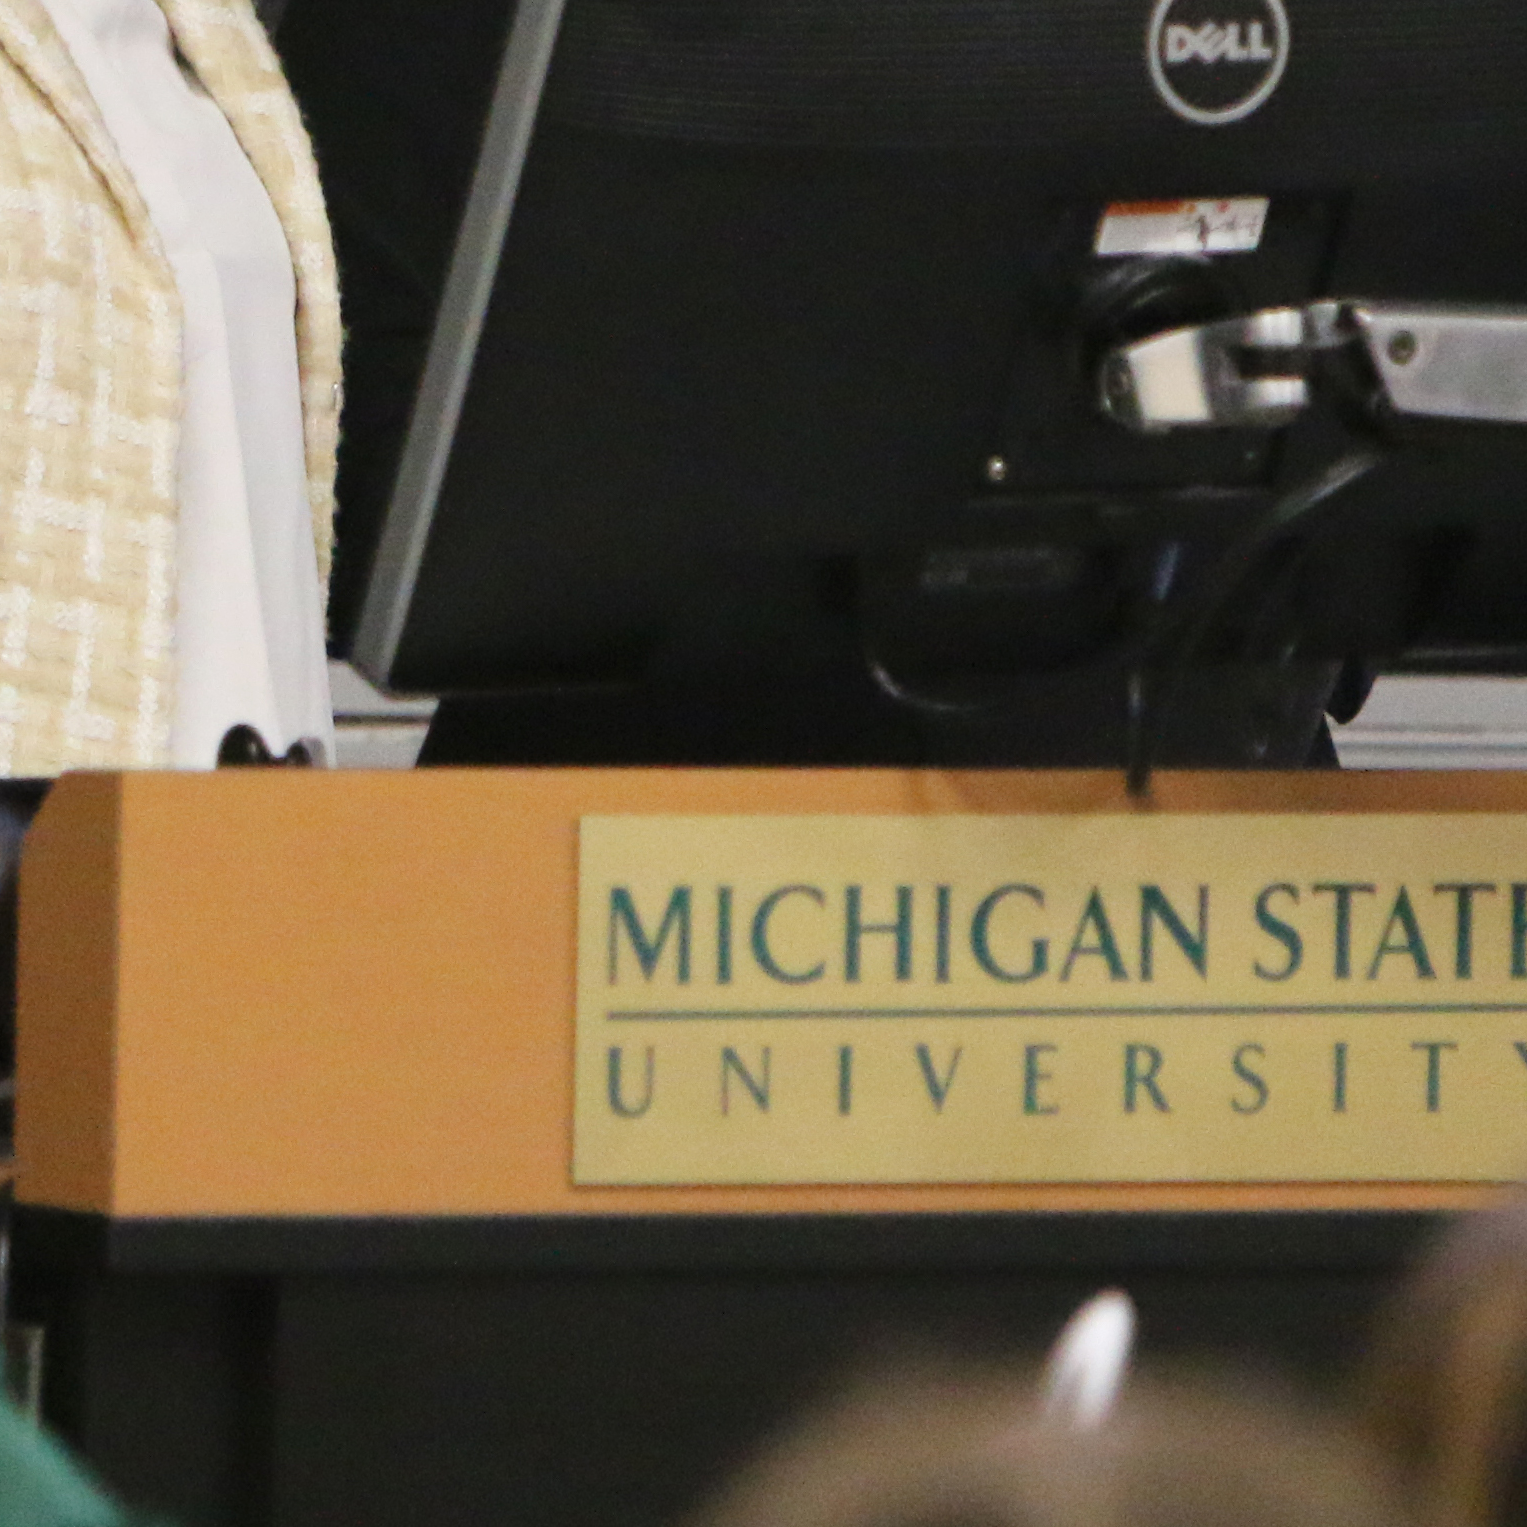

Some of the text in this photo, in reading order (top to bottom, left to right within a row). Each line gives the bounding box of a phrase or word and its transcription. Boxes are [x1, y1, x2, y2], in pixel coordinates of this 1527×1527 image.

[1166, 23, 1273, 63] DELL
[607, 882, 1210, 986] MICHIGAN
[606, 1040, 1527, 1119] UNIVERSIT
